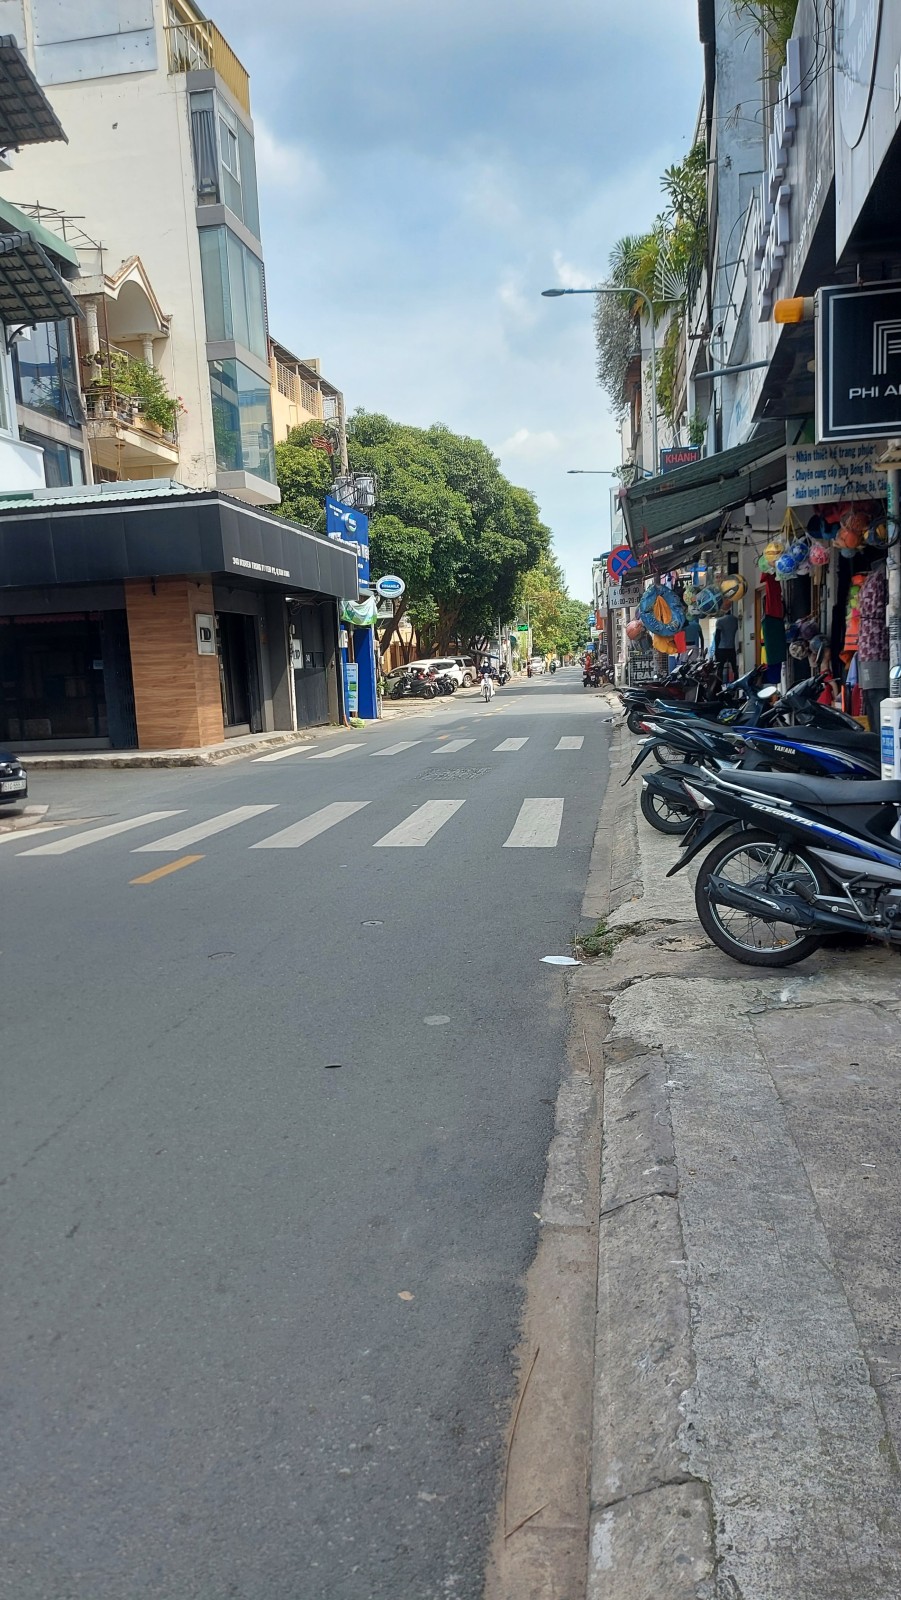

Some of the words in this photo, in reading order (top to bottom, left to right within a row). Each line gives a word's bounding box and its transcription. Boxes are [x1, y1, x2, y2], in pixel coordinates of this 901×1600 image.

[849, 386, 879, 399] PHI
[796, 451, 812, 464] Nhận
[839, 446, 856, 459] trang
[611, 597, 640, 606] 16:00-20:0
[774, 744, 796, 755] YAMAHA
